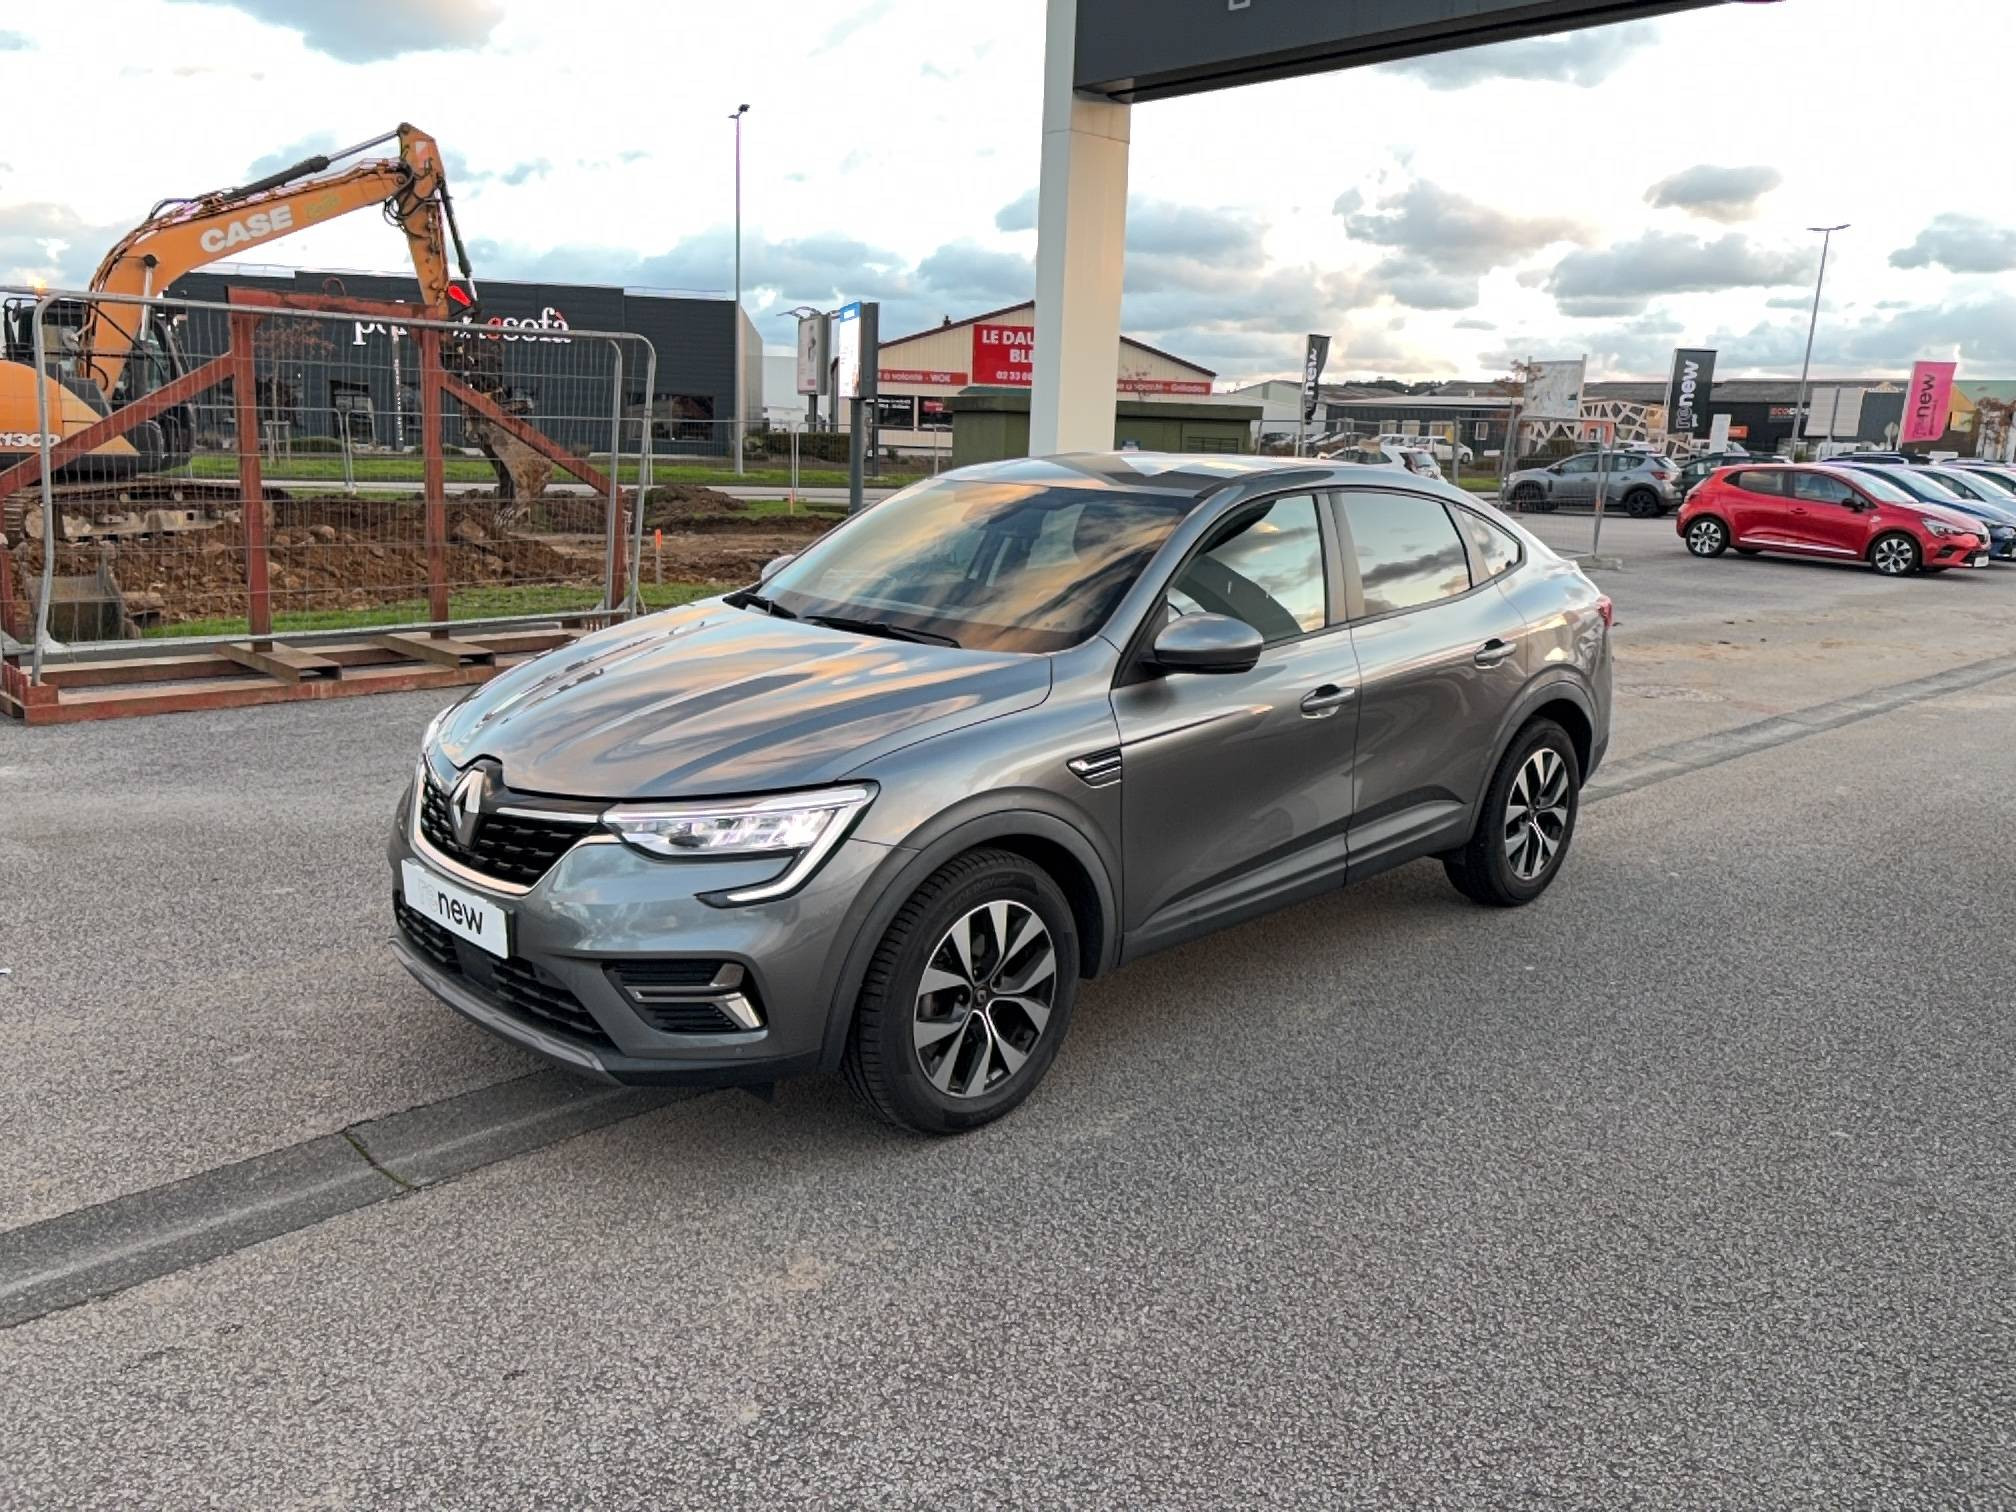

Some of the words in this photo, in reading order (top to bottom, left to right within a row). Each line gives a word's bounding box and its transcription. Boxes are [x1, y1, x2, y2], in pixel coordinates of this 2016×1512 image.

[201, 205, 293, 252] CASE
[982, 329, 999, 344] LE
[1675, 360, 1699, 429] renew
